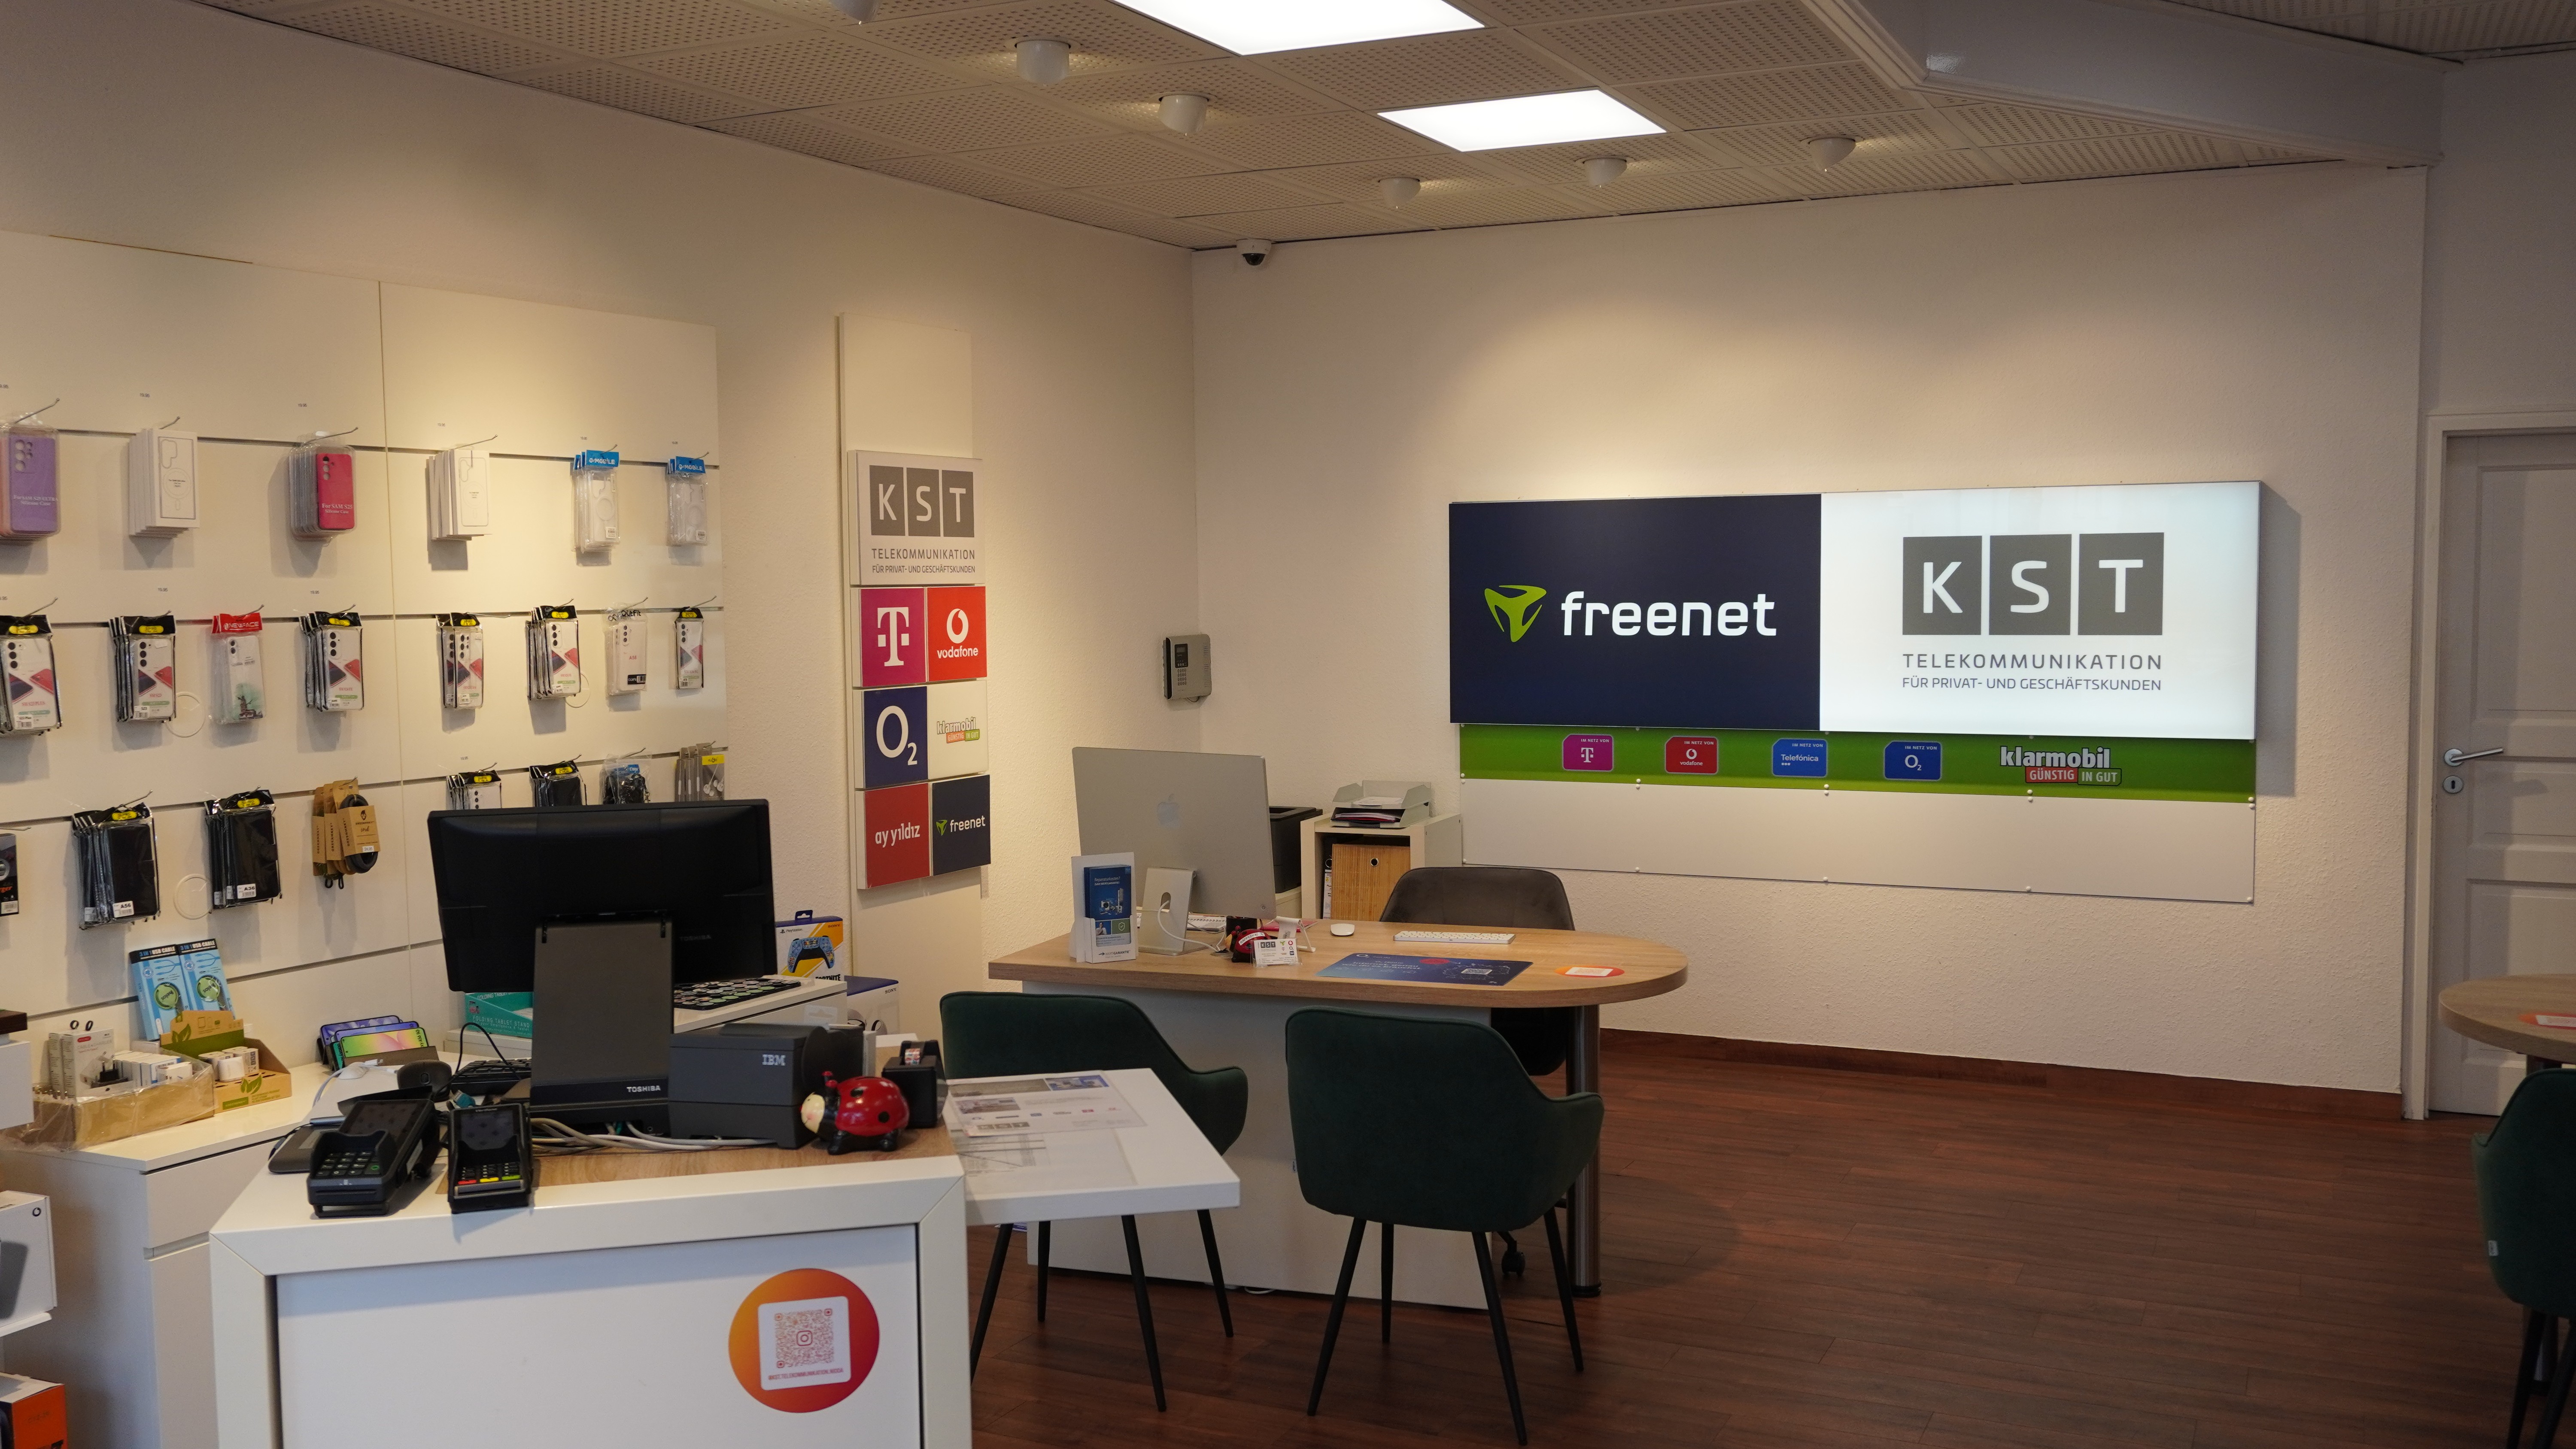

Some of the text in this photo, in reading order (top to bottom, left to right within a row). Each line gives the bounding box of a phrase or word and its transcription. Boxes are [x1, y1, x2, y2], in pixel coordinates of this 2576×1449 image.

[879, 484, 966, 522] KST
[872, 549, 975, 559] TELEKOMMUNIKATION
[872, 564, 884, 573] FÜR
[922, 564, 975, 573] GESCHÄFTSKUNDEN
[1923, 559, 2143, 613] KST
[1561, 591, 1777, 636] freenet
[937, 646, 978, 659] vodafone
[1903, 654, 2161, 670] TELEKOMMUNIKATION
[1903, 676, 2161, 691] FÜR PRIVAT- UND GESCHÄFTSKUNDEN
[937, 717, 976, 735] klarmobil
[948, 732, 964, 741] GÜNSTIG
[1781, 754, 1819, 762] Telefónica
[2000, 746, 2111, 768] klarmobil
[2029, 768, 2118, 782] GÜNSTIG IN GUT
[950, 815, 986, 833] freenet
[875, 830, 889, 848] ay
[762, 1054, 786, 1066] IBM
